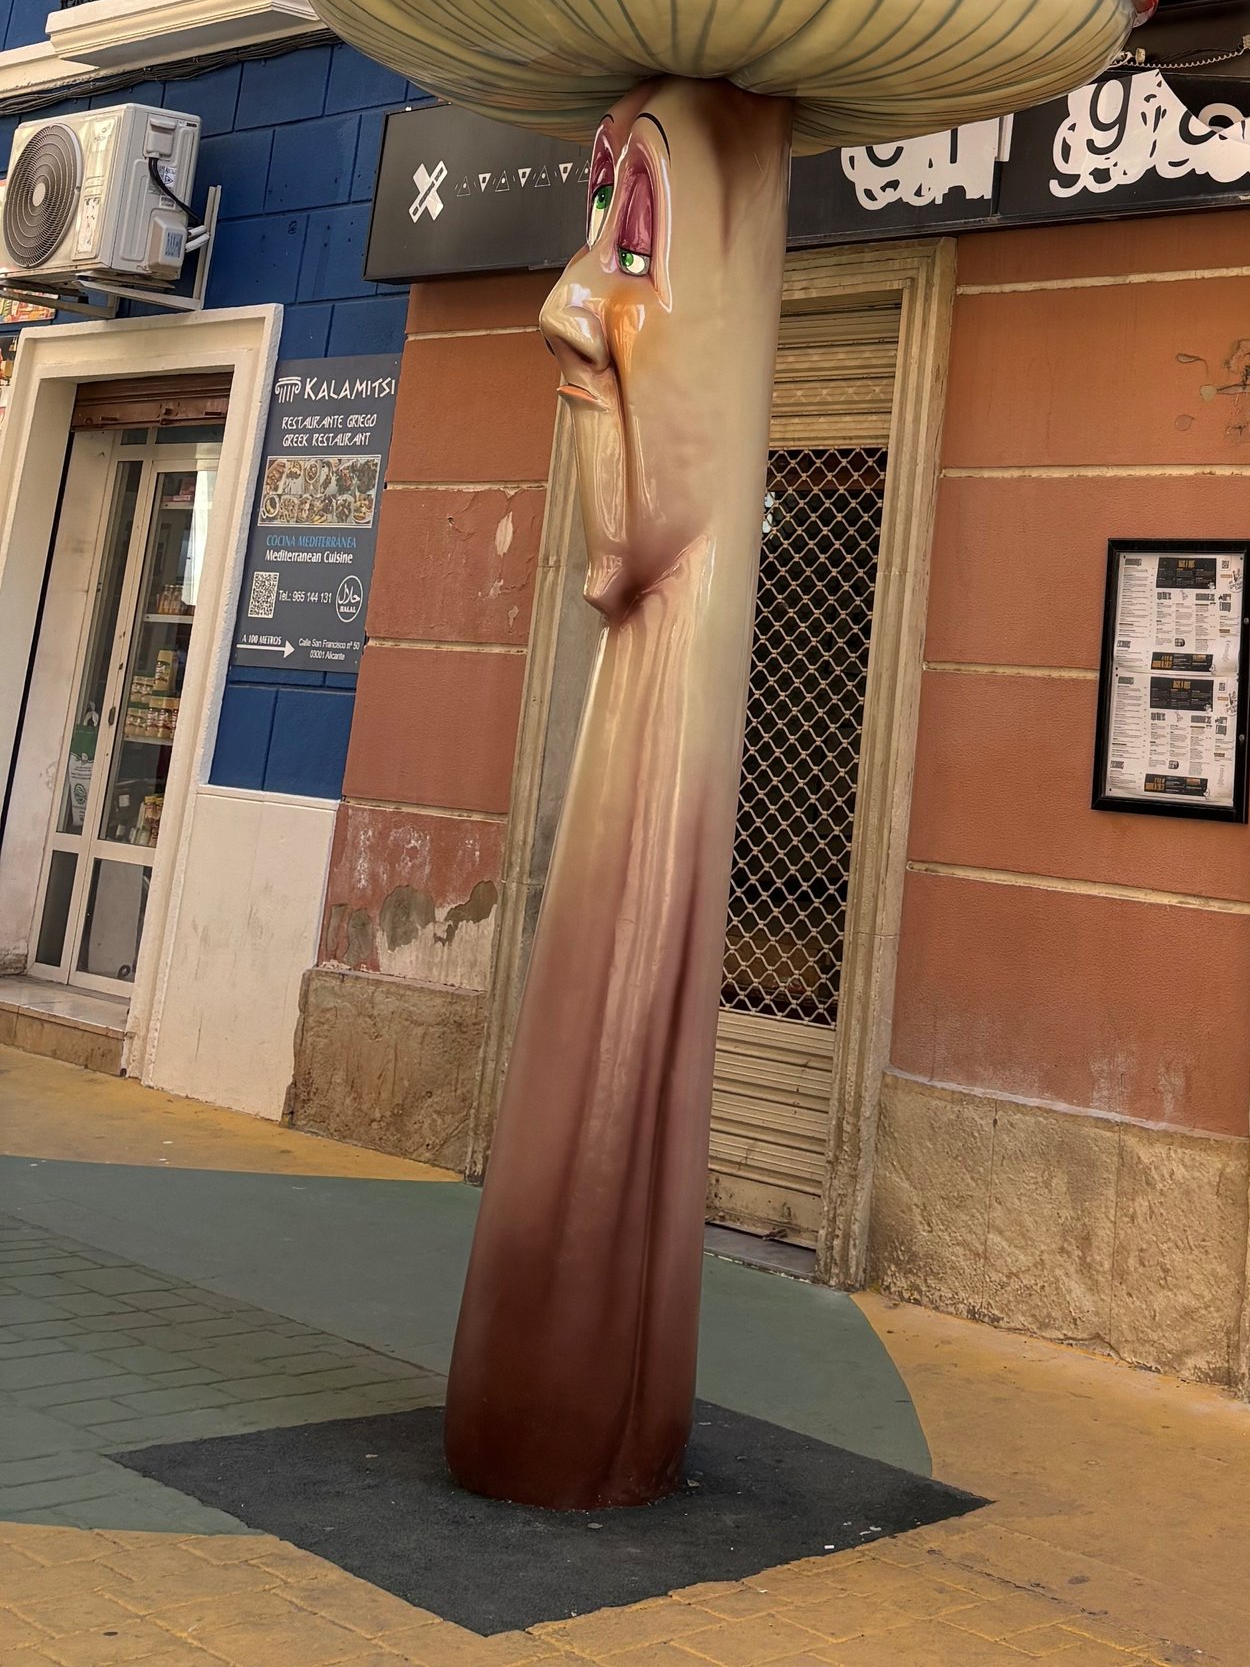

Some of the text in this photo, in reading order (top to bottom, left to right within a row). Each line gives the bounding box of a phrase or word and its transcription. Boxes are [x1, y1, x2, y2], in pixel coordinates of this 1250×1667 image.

[304, 377, 395, 400] KALAMITSI
[282, 414, 377, 429] RESTAURANTE GRIEGO
[283, 432, 371, 447] GREEK RESTAURANT
[266, 535, 295, 546] COCINA
[265, 550, 353, 564] Mediterranean Cuisine
[292, 591, 305, 602] 965
[307, 592, 318, 602] 144
[321, 592, 332, 603] 131
